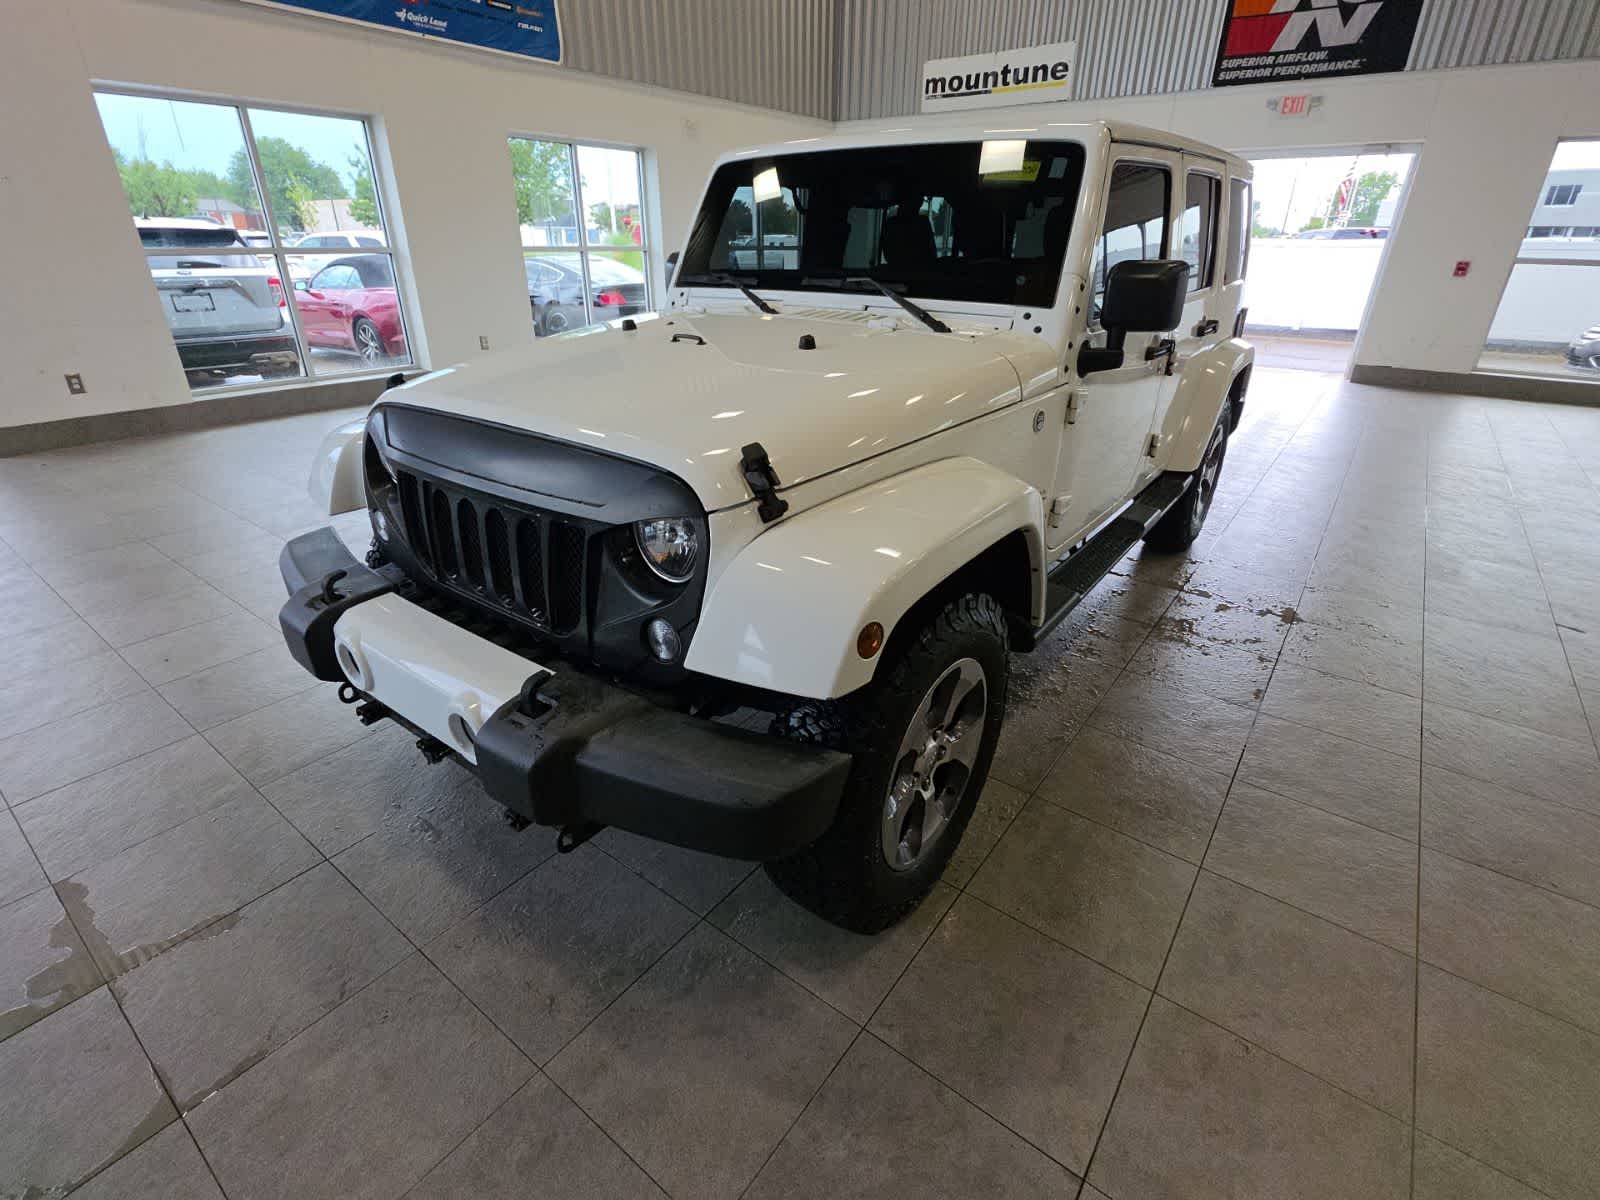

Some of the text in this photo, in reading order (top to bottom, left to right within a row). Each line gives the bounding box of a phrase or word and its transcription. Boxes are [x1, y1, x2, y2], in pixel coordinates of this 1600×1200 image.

[407, 12, 429, 24] Quick
[1220, 55, 1275, 69] SUPERIOR
[924, 61, 1070, 95] mountune
[1218, 66, 1273, 81] SUPERIOR
[1281, 96, 1306, 114] EXIT
